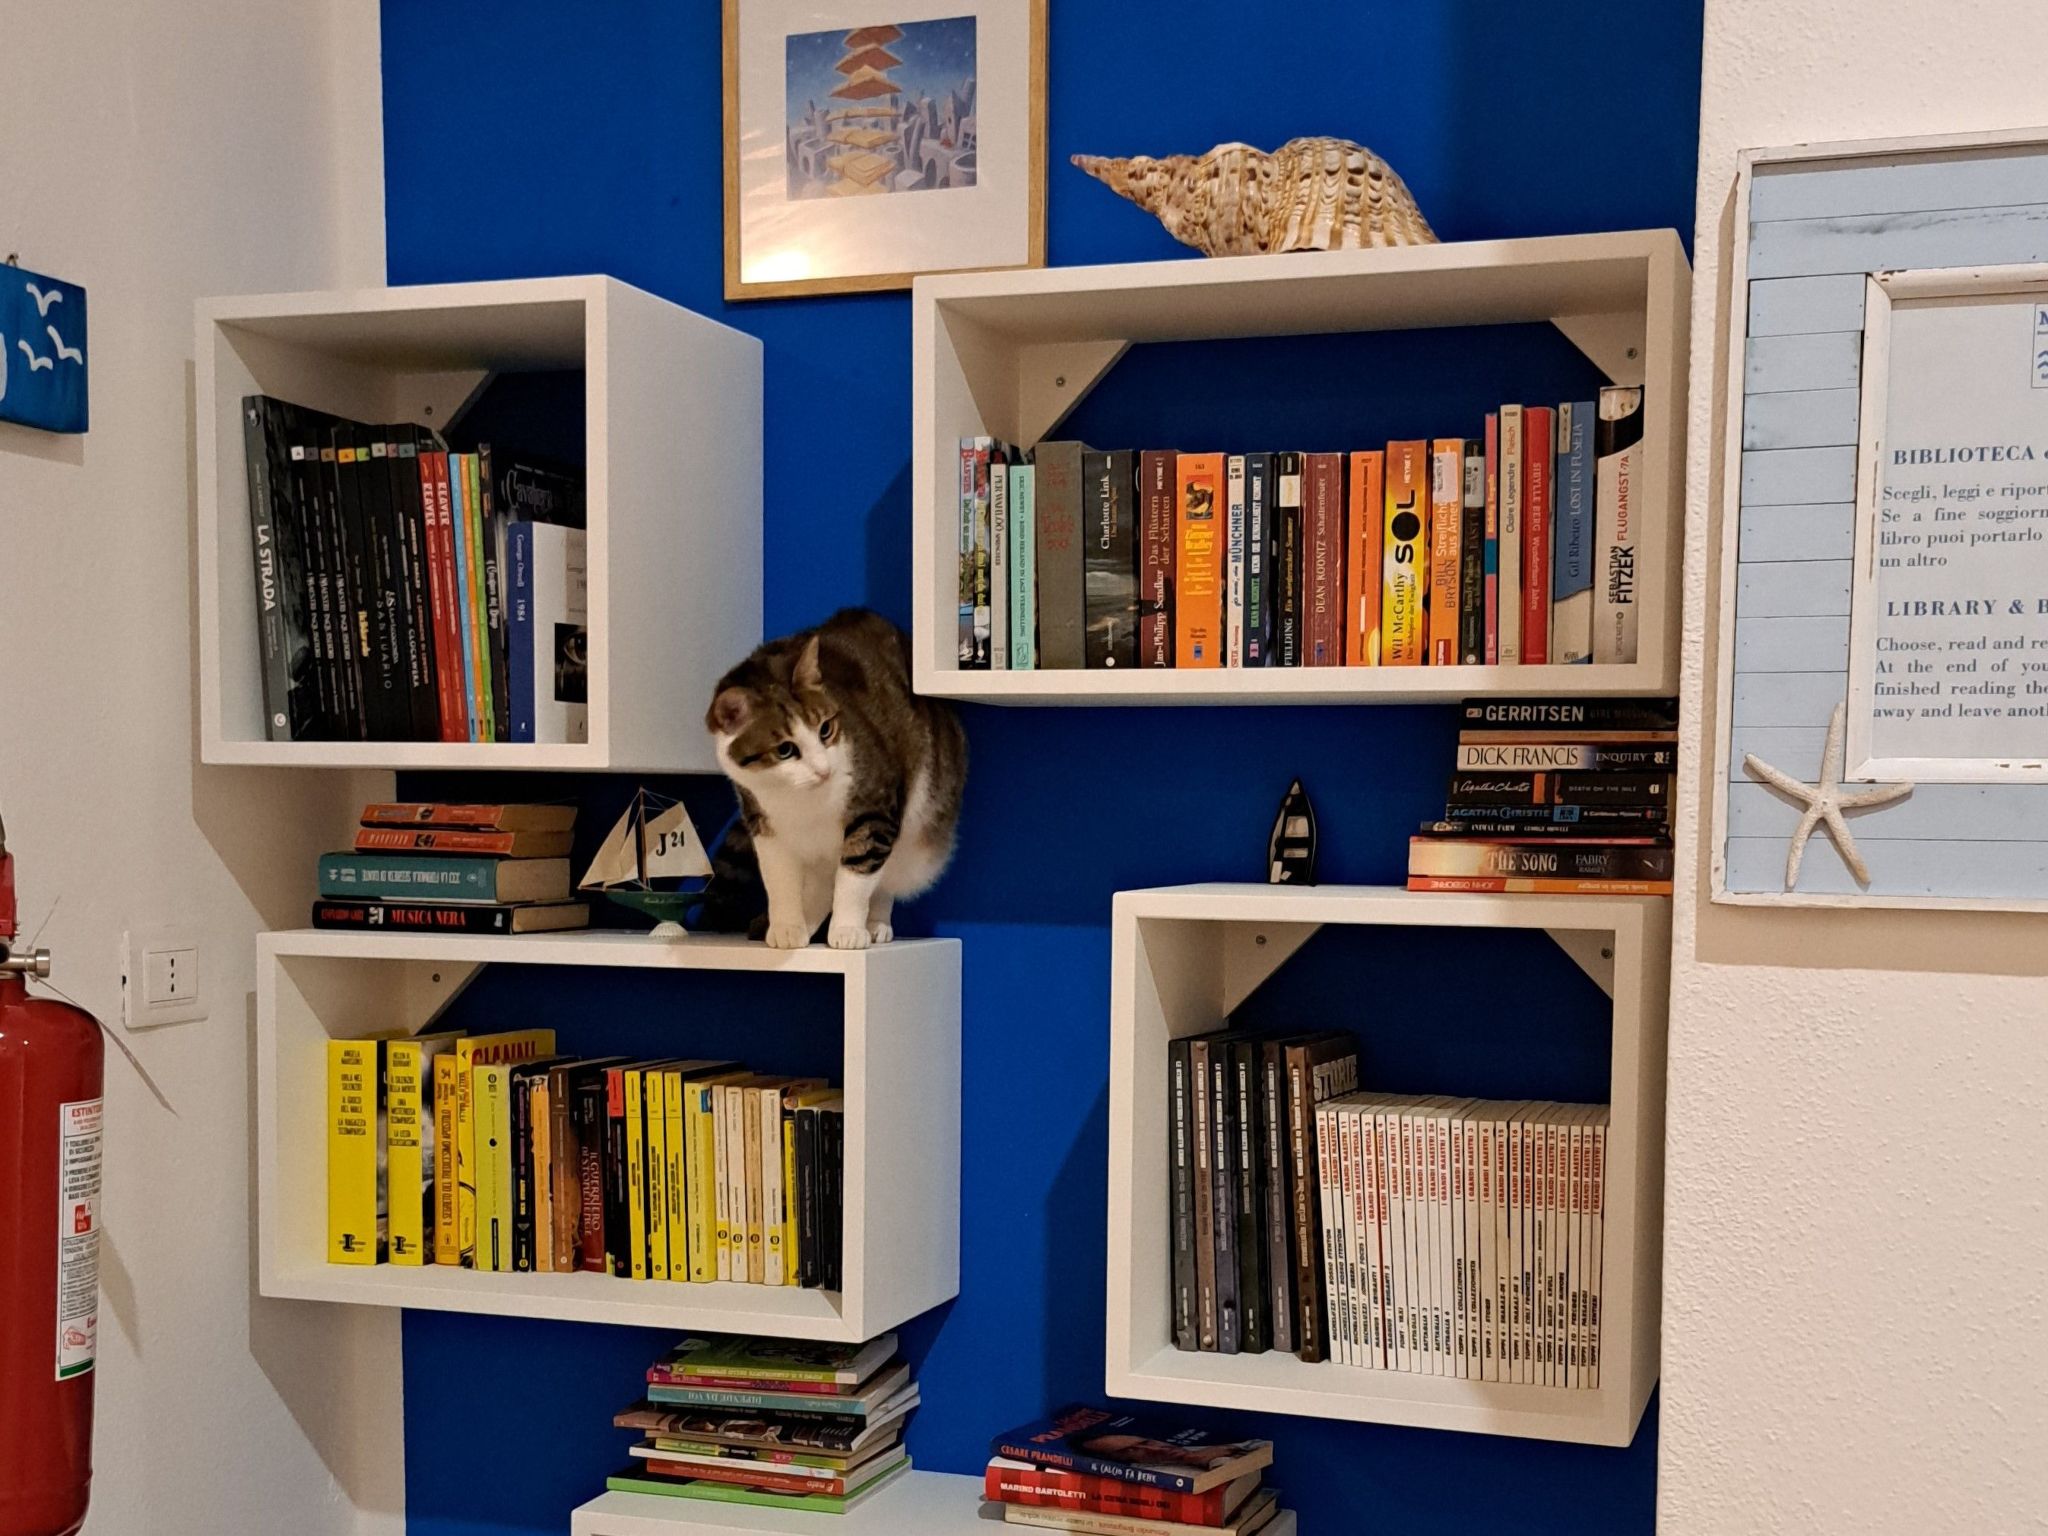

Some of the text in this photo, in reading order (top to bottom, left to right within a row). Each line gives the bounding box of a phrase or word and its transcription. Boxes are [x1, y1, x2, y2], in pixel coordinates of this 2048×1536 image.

[1894, 445, 2034, 465] BIBLIOTECA
[994, 475, 1004, 492] PER
[1505, 462, 1517, 505] Legendre
[1531, 462, 1541, 502] SIBYLLE
[1570, 469, 1581, 483] IN
[423, 482, 436, 526] REAVER
[437, 481, 450, 525] REAVER
[1570, 486, 1581, 515] LOST
[1616, 472, 1630, 541] FLUGANGST
[1883, 484, 1995, 503] Scegli, leggi e
[1100, 475, 1111, 550] Charlotte Link
[1391, 489, 1420, 564] SOL
[1505, 506, 1516, 533] Claire
[1531, 505, 1541, 532] BERG
[1881, 508, 1901, 523] Se
[1912, 511, 1922, 521] a
[1934, 507, 1967, 521] fine
[1147, 495, 1159, 565] Das Flüstern
[1160, 495, 1170, 565] der Schatten
[1228, 503, 1243, 563] MÜNCHNER
[1569, 518, 1580, 558] Ribeiro
[1880, 527, 2043, 548] libro puoi portarlo
[1316, 477, 1326, 613] DEAN KOONTZ Schattenfeuer
[1448, 539, 1458, 557] aus
[258, 525, 276, 611] LA STRADA
[1436, 560, 1447, 586] BILL
[1569, 559, 1580, 578] Gil
[1608, 545, 1619, 604] SEBASTIAN
[1617, 545, 1634, 604] FITZEK
[1880, 552, 1948, 568] un altro
[1445, 558, 1456, 609] BRYSON
[516, 598, 526, 621] 1984
[1152, 569, 1166, 666] Jan-Philipp Sendker
[1391, 573, 1408, 660] Wil McCarthy
[1888, 599, 2024, 616] LIBRARY &
[1284, 618, 1293, 666] FIELDING
[1876, 635, 2025, 652] Choose, read and
[1876, 659, 1894, 673] At
[1907, 659, 1933, 673] the
[1946, 659, 1977, 672] end
[1991, 658, 2009, 672] of
[1874, 681, 1941, 696] finished
[1951, 681, 2016, 699] reading
[1486, 705, 1584, 722] GERRITSEN
[1873, 703, 2002, 722] away and leave
[1466, 747, 1648, 766] DICK FRANCIS ENQUIRY
[1452, 807, 1551, 819] AGATHA CHRISTIE
[656, 831, 685, 856] J 24
[1488, 851, 1557, 872] THE SONG
[1576, 854, 1610, 866] FABRY
[391, 909, 466, 926] MUSICA NERA
[1319, 1124, 1329, 1184] GRANDI MAESTRI
[1341, 1132, 1351, 1191] GRANDI MAESTRI
[1390, 1134, 1399, 1194] GRANDI MAESTRI
[1403, 1135, 1411, 1165] MAESTRI
[1365, 1130, 1376, 1218] GRANDI MAESTRI SPECIAL
[589, 1152, 603, 1230] IL GUERRIERO
[1329, 1300, 1338, 1341] MICHELUZZI
[1351, 1303, 1359, 1345] MICHELUZZI
[1422, 1315, 1430, 1351] BATTAGLIA
[1444, 1319, 1452, 1355] BATTAGLIA
[687, 1391, 762, 1405] DIPENDE DA VOI
[1000, 1445, 1074, 1467] CESARE PRANDELLI
[1125, 1468, 1136, 1480] FA
[1137, 1470, 1158, 1484] BENE
[1000, 1482, 1087, 1500] MARINO BARTOLETTI
